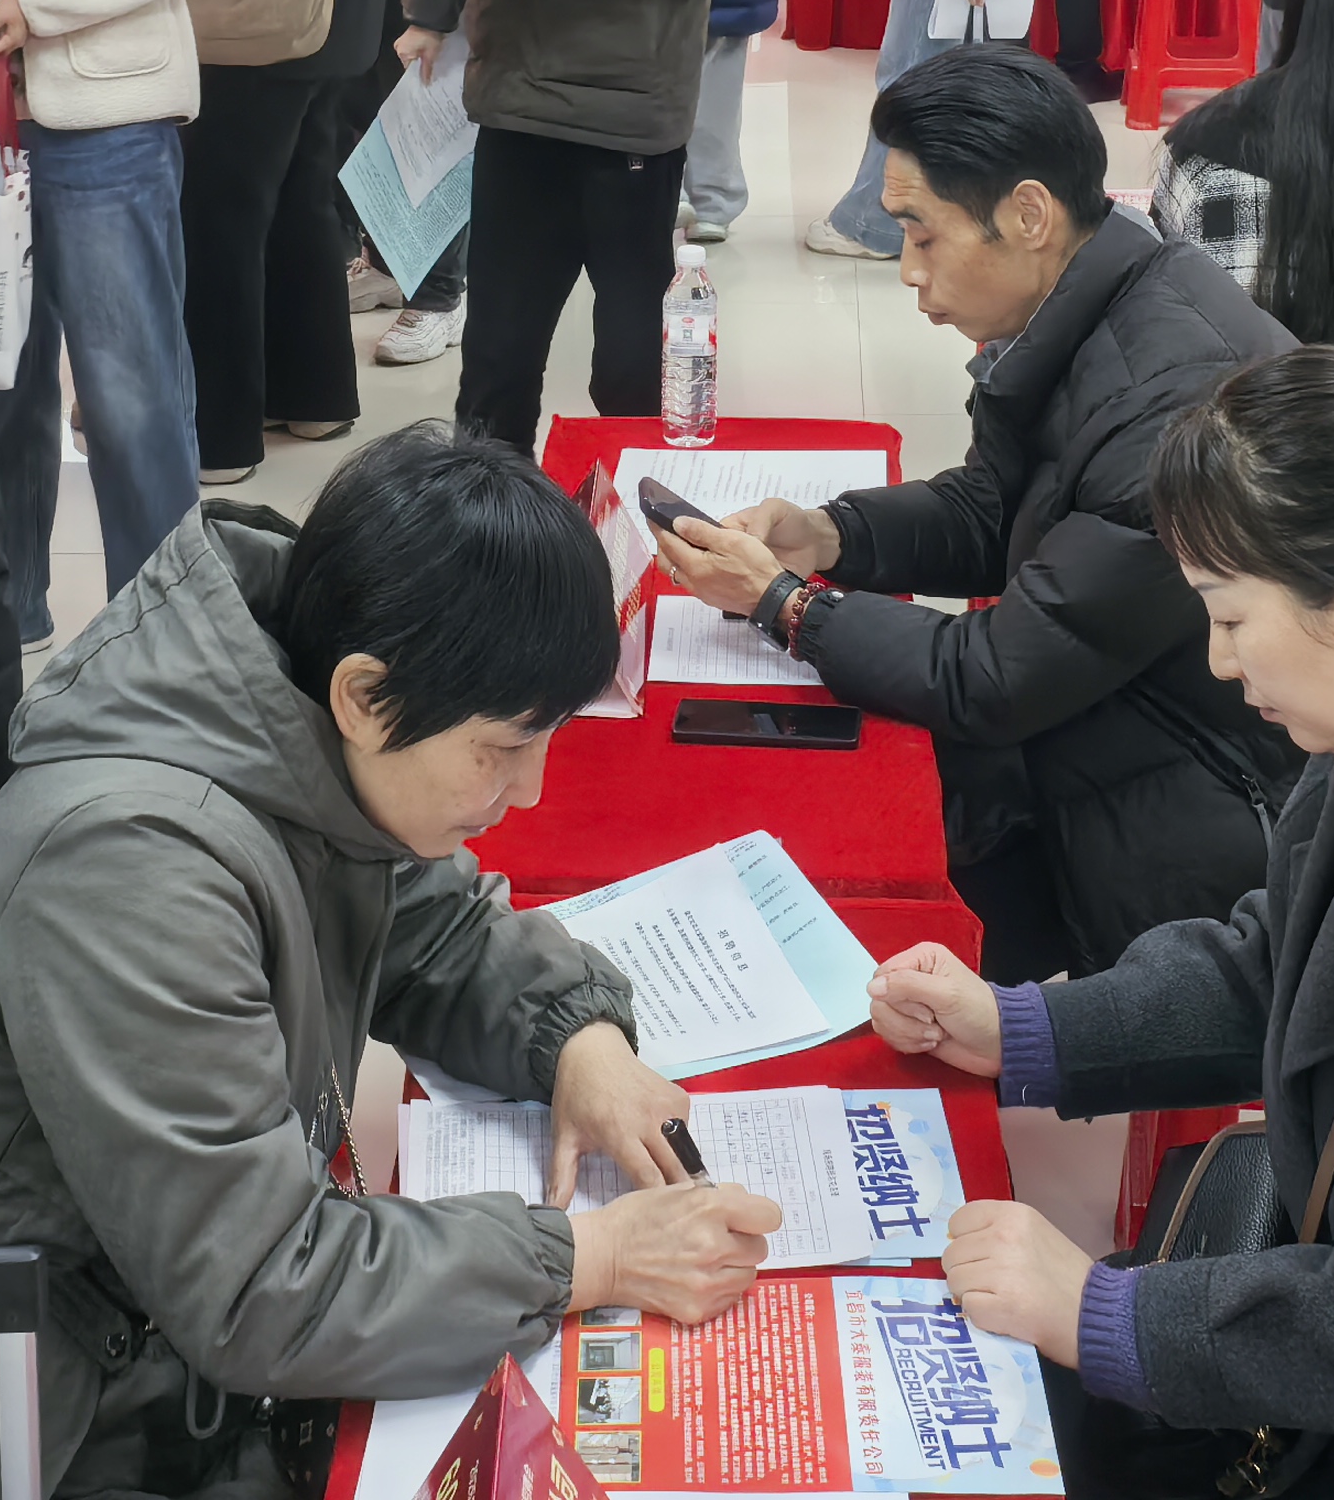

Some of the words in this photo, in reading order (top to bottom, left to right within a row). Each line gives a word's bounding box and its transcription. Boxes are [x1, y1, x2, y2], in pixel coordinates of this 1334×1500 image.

[845, 1103, 930, 1240] 招贤纳士
[871, 1297, 1012, 1469] 招贤纳士
[895, 1347, 947, 1470] RECRUITMENT
